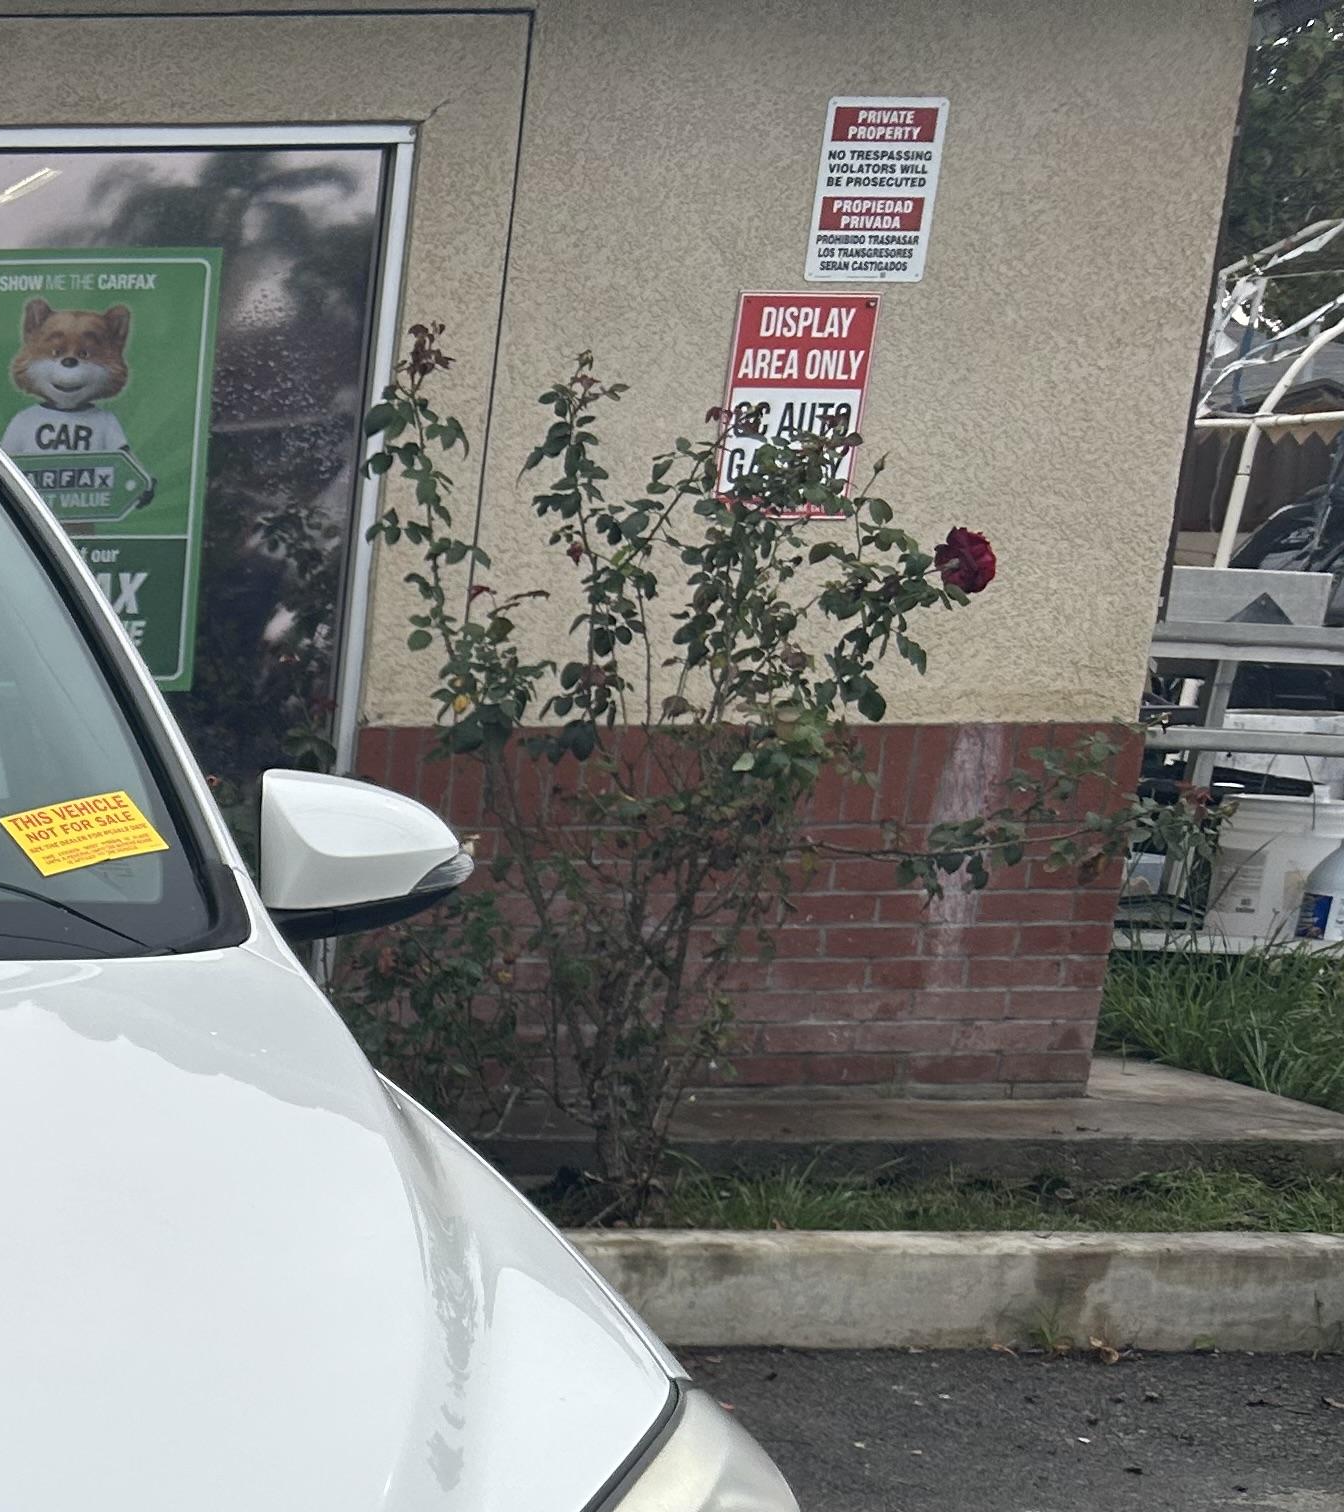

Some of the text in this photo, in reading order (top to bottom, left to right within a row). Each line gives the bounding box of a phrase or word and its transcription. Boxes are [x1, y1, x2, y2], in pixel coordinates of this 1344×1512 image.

[858, 110, 916, 124] PRIVATE
[847, 126, 922, 140] PROPERTY
[828, 150, 932, 161] NO TRESPASSING
[829, 163, 928, 175] VIOLATORS WILL
[826, 176, 927, 188] BE PROSECUTED
[832, 200, 913, 214] PROPIEDAD
[840, 215, 901, 229] PRIVADA
[816, 234, 920, 245] PROHIBIDO TRASPASAR
[818, 247, 914, 259] LOS TRANSGRESORES
[819, 260, 908, 272] SERAN CASTIGADOS
[45, 274, 66, 290] ME
[69, 274, 94, 290] THE
[97, 273, 157, 290] CARFAX
[759, 306, 856, 338] DISPLAY
[737, 348, 865, 380] AREA ONLY
[776, 402, 852, 439] AUTO
[35, 423, 93, 451] CAR
[24, 467, 113, 489] ARFAX
[61, 493, 111, 508] VALUE
[91, 549, 119, 562] our
[8, 795, 129, 832] THIS VEHICLE
[25, 810, 136, 844] NOT FOR SALE
